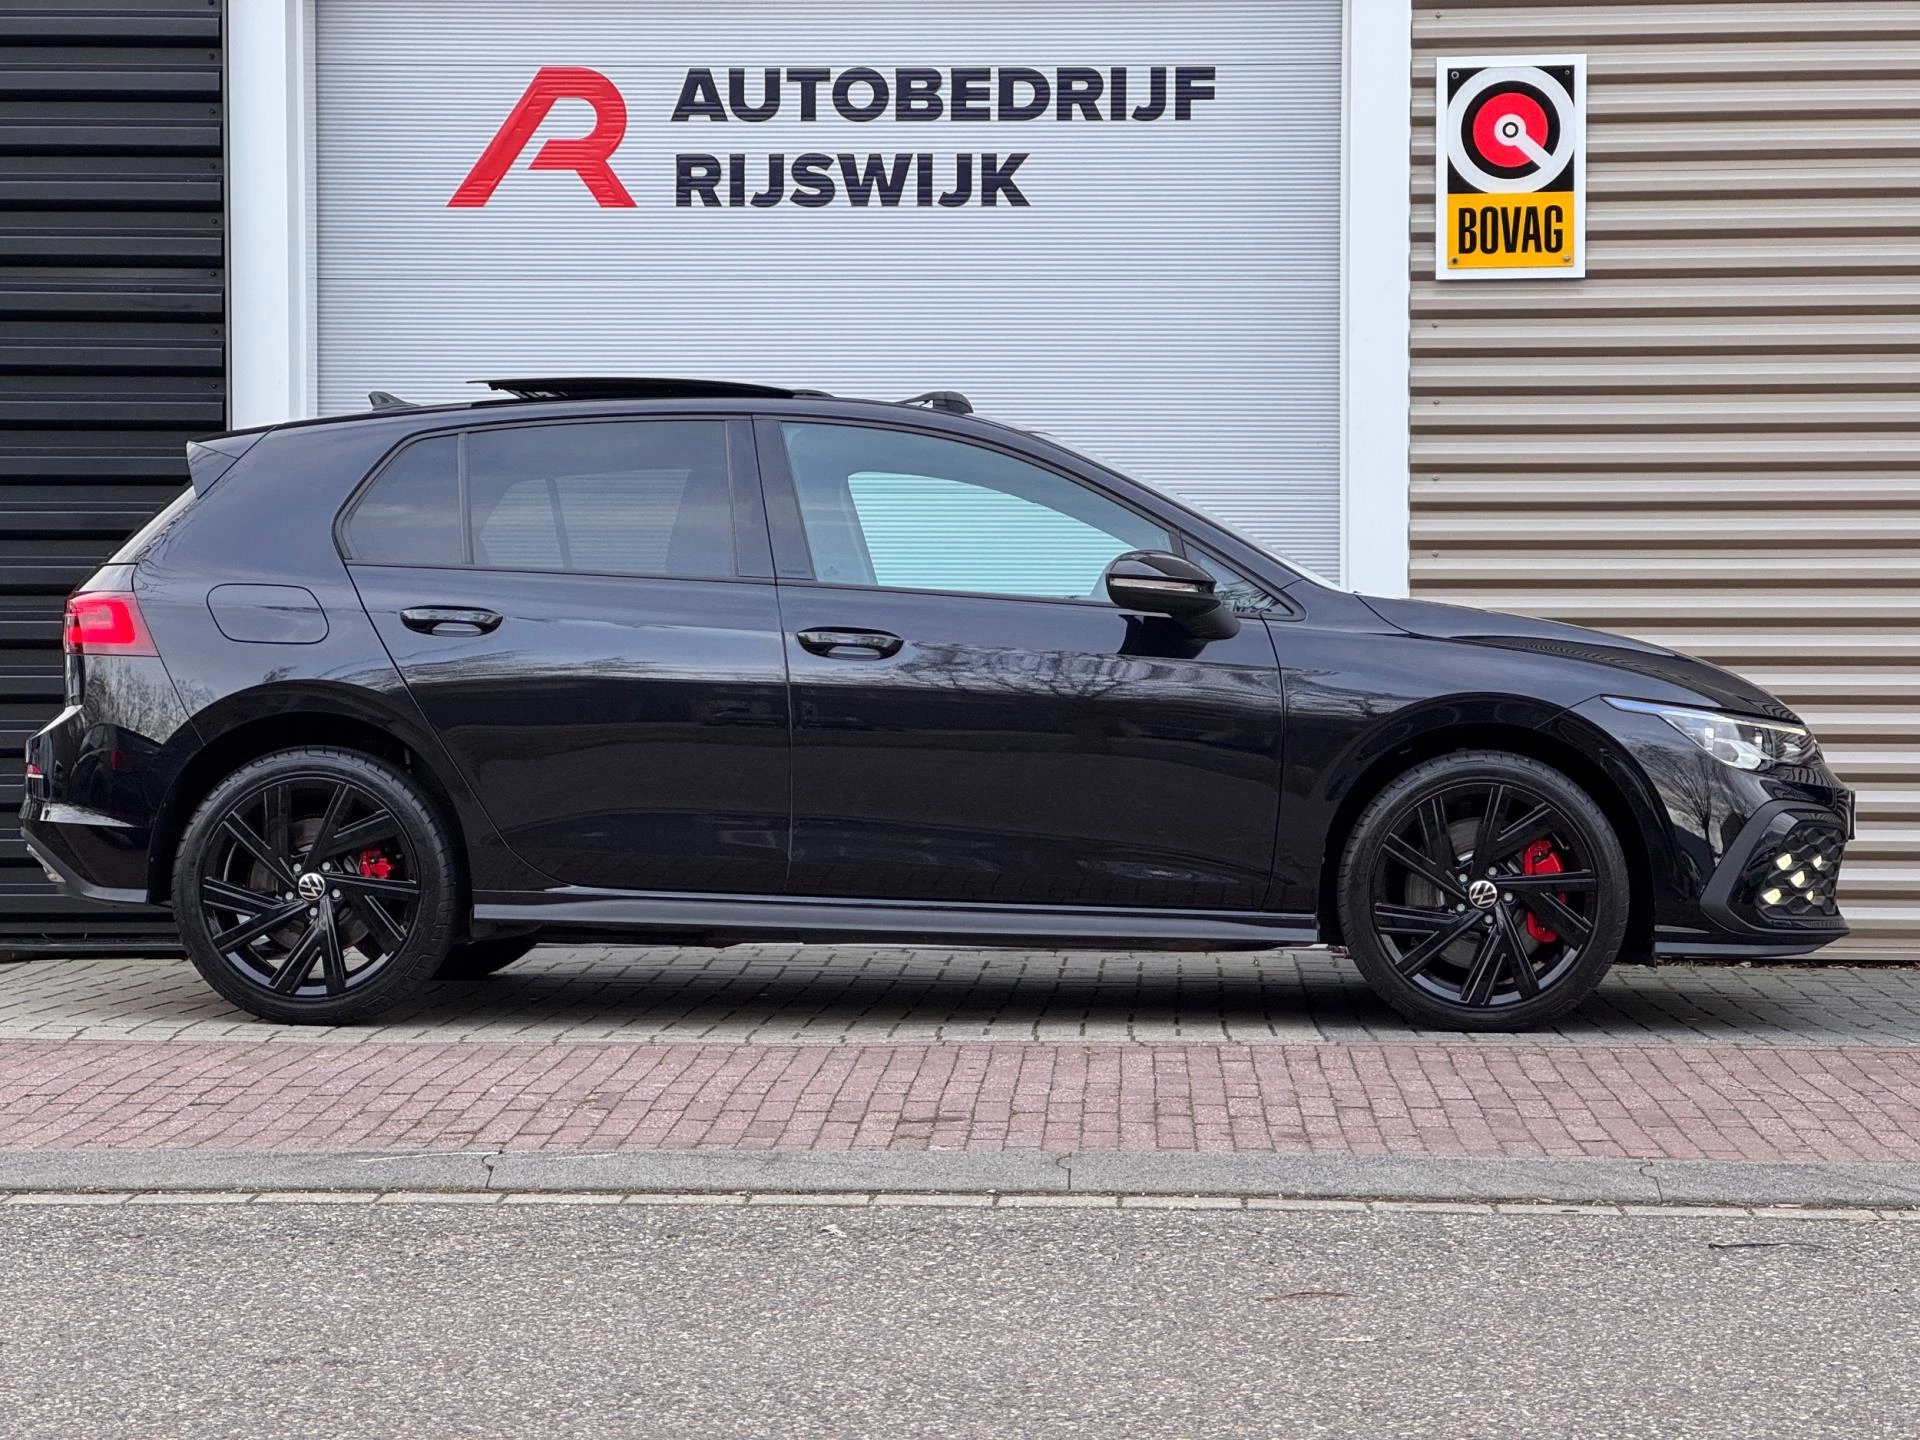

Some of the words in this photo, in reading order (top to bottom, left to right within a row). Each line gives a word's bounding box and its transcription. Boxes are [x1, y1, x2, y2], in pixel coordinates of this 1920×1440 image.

[671, 67, 1216, 122] AUTOBEDRIJF
[675, 153, 1031, 208] RIJSWIJK
[1458, 205, 1563, 255] BOVAG
